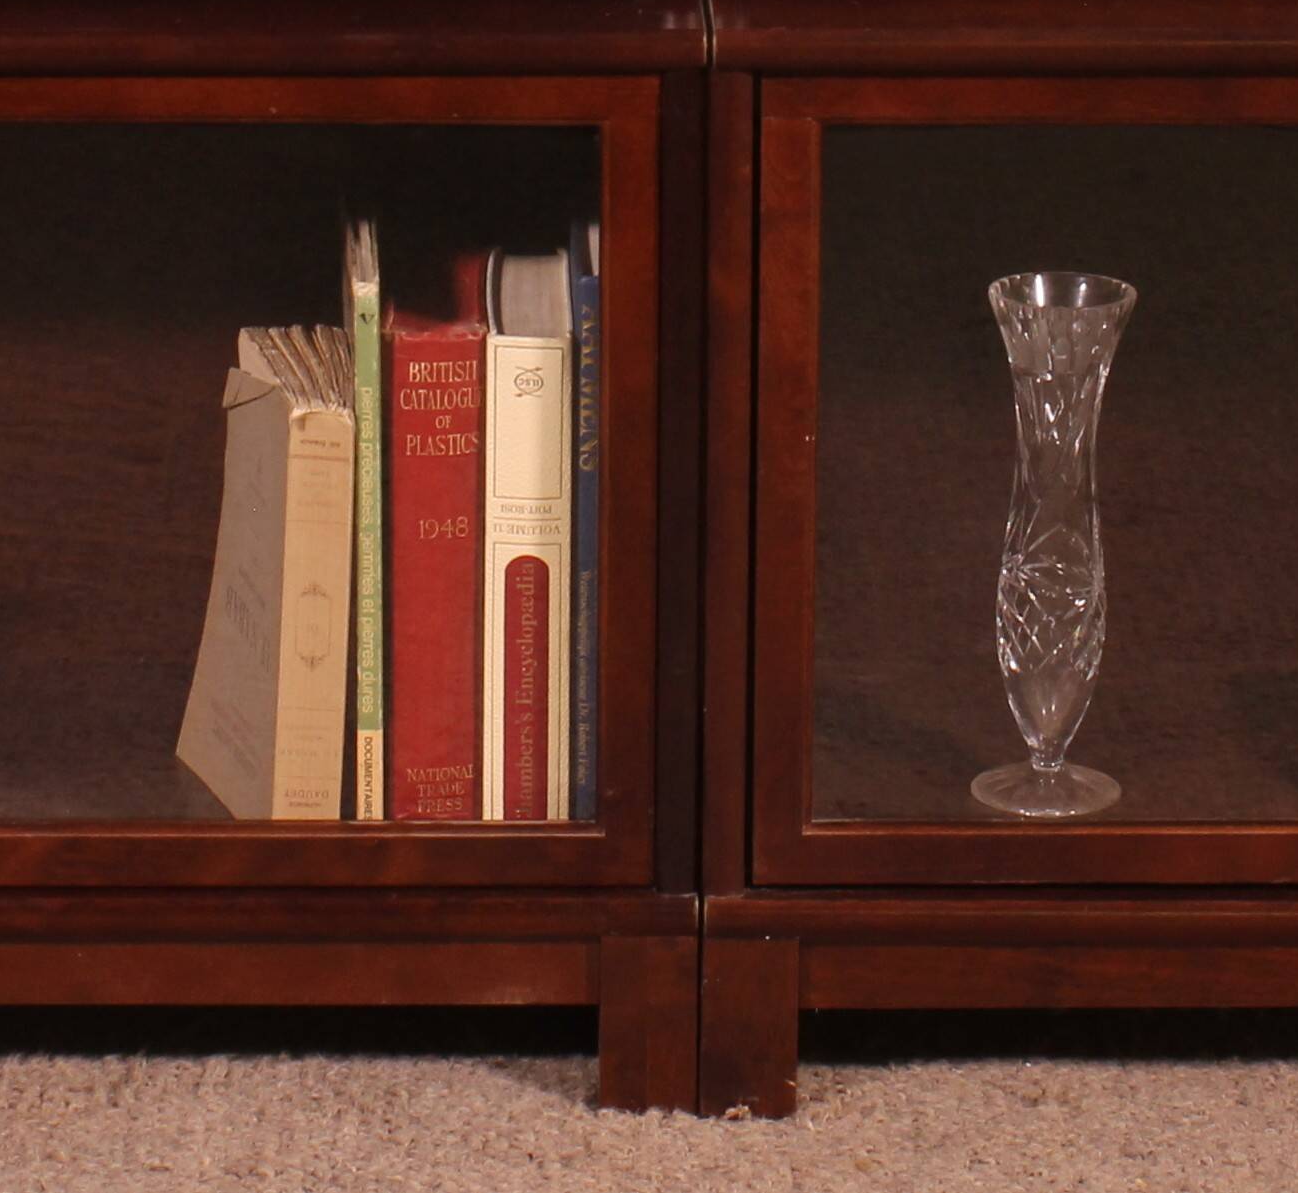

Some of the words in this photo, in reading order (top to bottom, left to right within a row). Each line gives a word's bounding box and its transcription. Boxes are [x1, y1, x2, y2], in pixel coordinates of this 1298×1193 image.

[408, 360, 478, 383] BRITISH
[360, 386, 373, 439] pierres
[435, 415, 452, 429] OF
[405, 431, 480, 456] PLASTICS
[418, 516, 470, 539] 1948
[510, 522, 561, 535] VOLUME
[360, 531, 373, 596] gemmes
[361, 598, 374, 613] et
[359, 617, 374, 668] pierres
[361, 671, 375, 713] dures
[363, 736, 373, 821] DOCUMENTAIRES
[406, 764, 474, 782] NATIONAL
[417, 781, 465, 797] TRADE
[417, 797, 463, 813] PRESS
